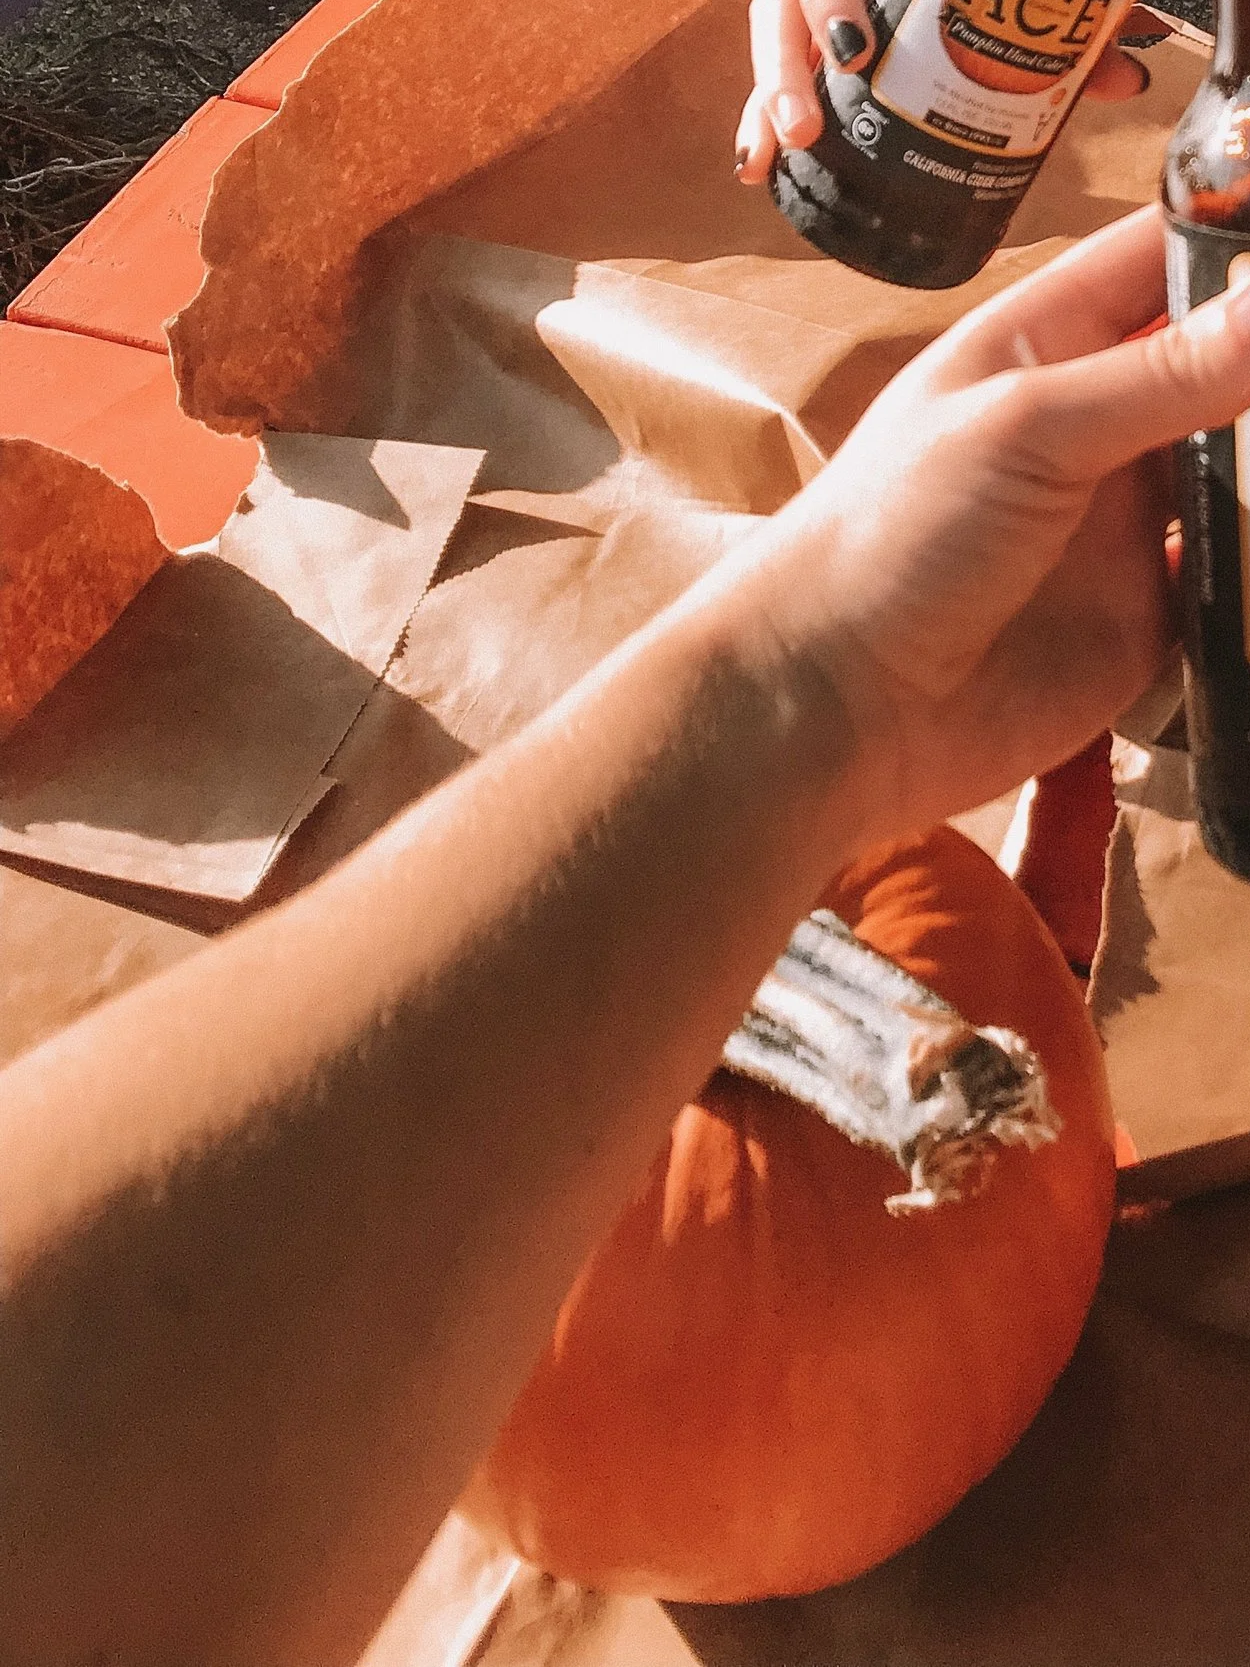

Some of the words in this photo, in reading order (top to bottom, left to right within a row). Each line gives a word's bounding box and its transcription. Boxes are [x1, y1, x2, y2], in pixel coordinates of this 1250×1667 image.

[951, 20, 1004, 56] Pumpkin
[903, 149, 967, 185] CALIFORNIA
[966, 172, 998, 188] CIDER
